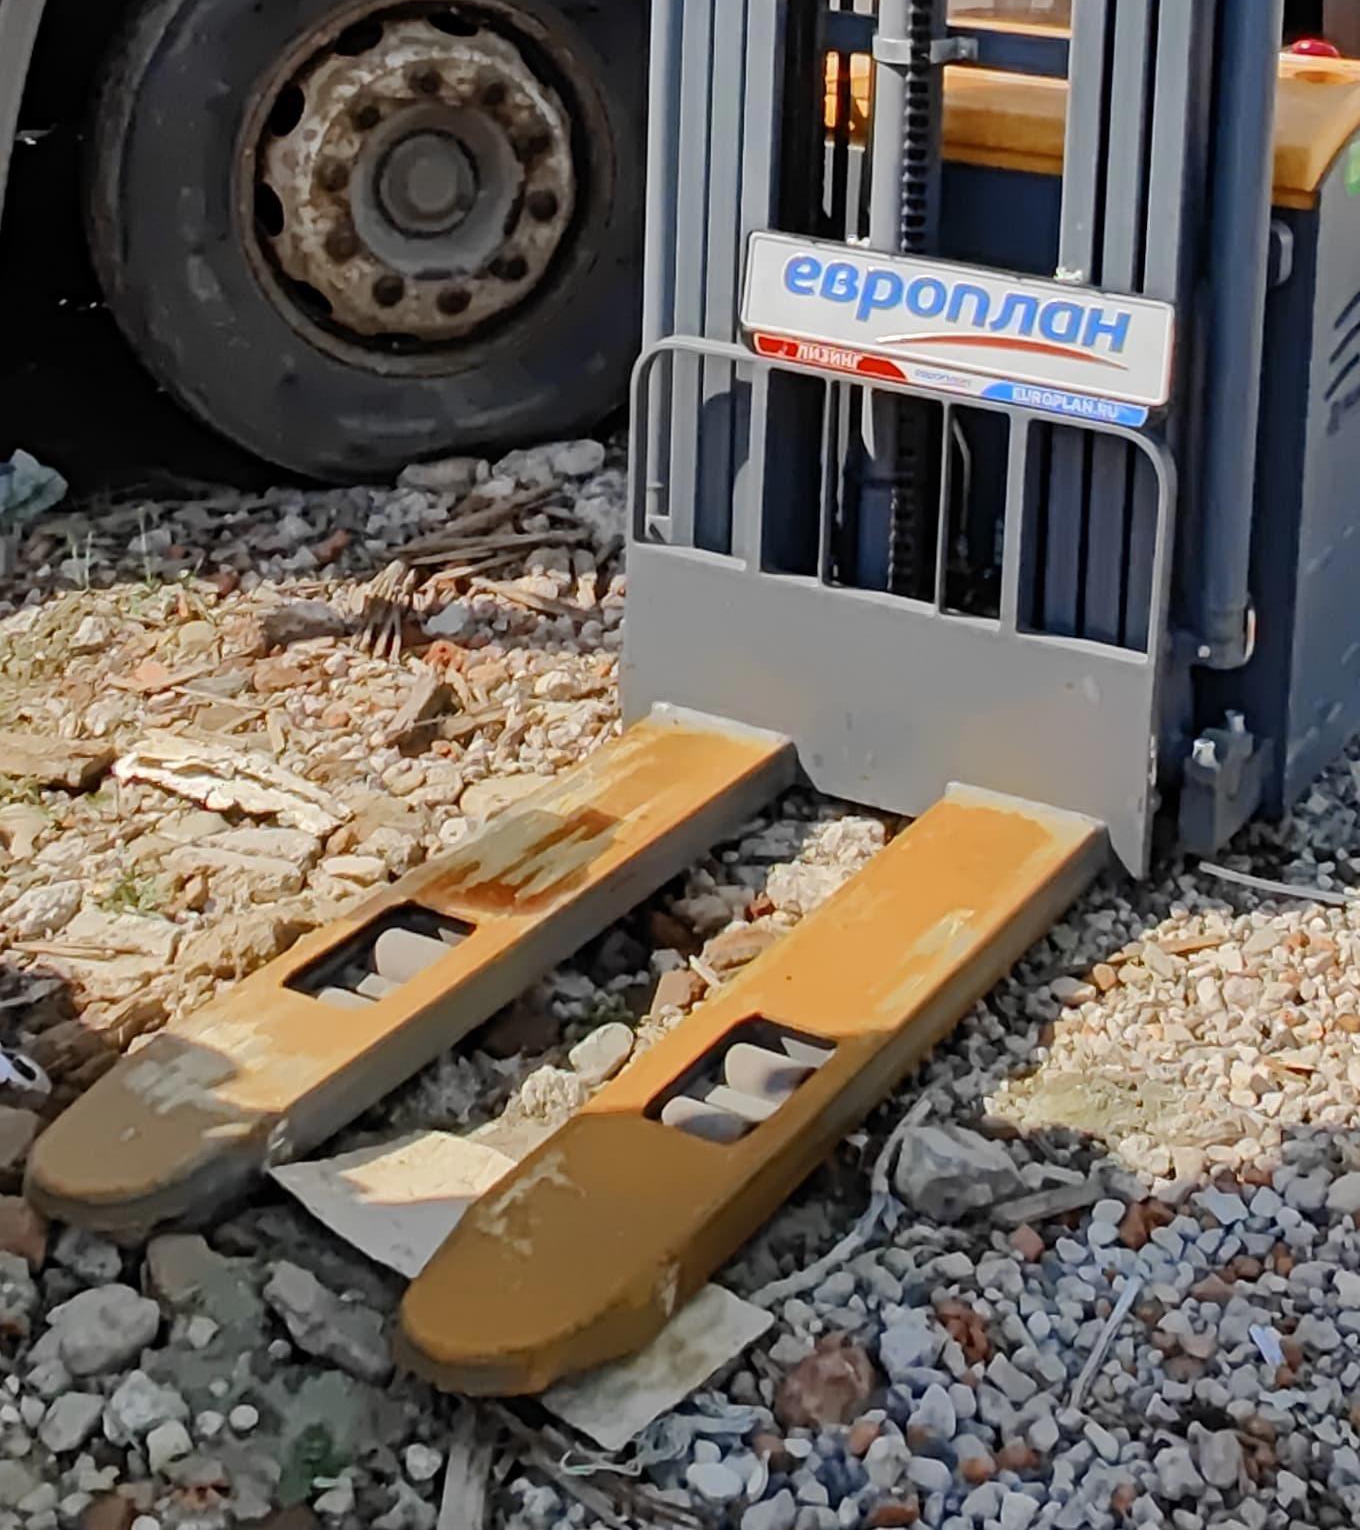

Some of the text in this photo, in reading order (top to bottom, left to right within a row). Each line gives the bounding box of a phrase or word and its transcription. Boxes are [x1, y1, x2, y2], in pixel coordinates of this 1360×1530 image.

[784, 254, 1131, 352] европлан
[796, 343, 863, 371] ЛИЗИНГ
[1011, 385, 1121, 419] EUROPLAN.RU
